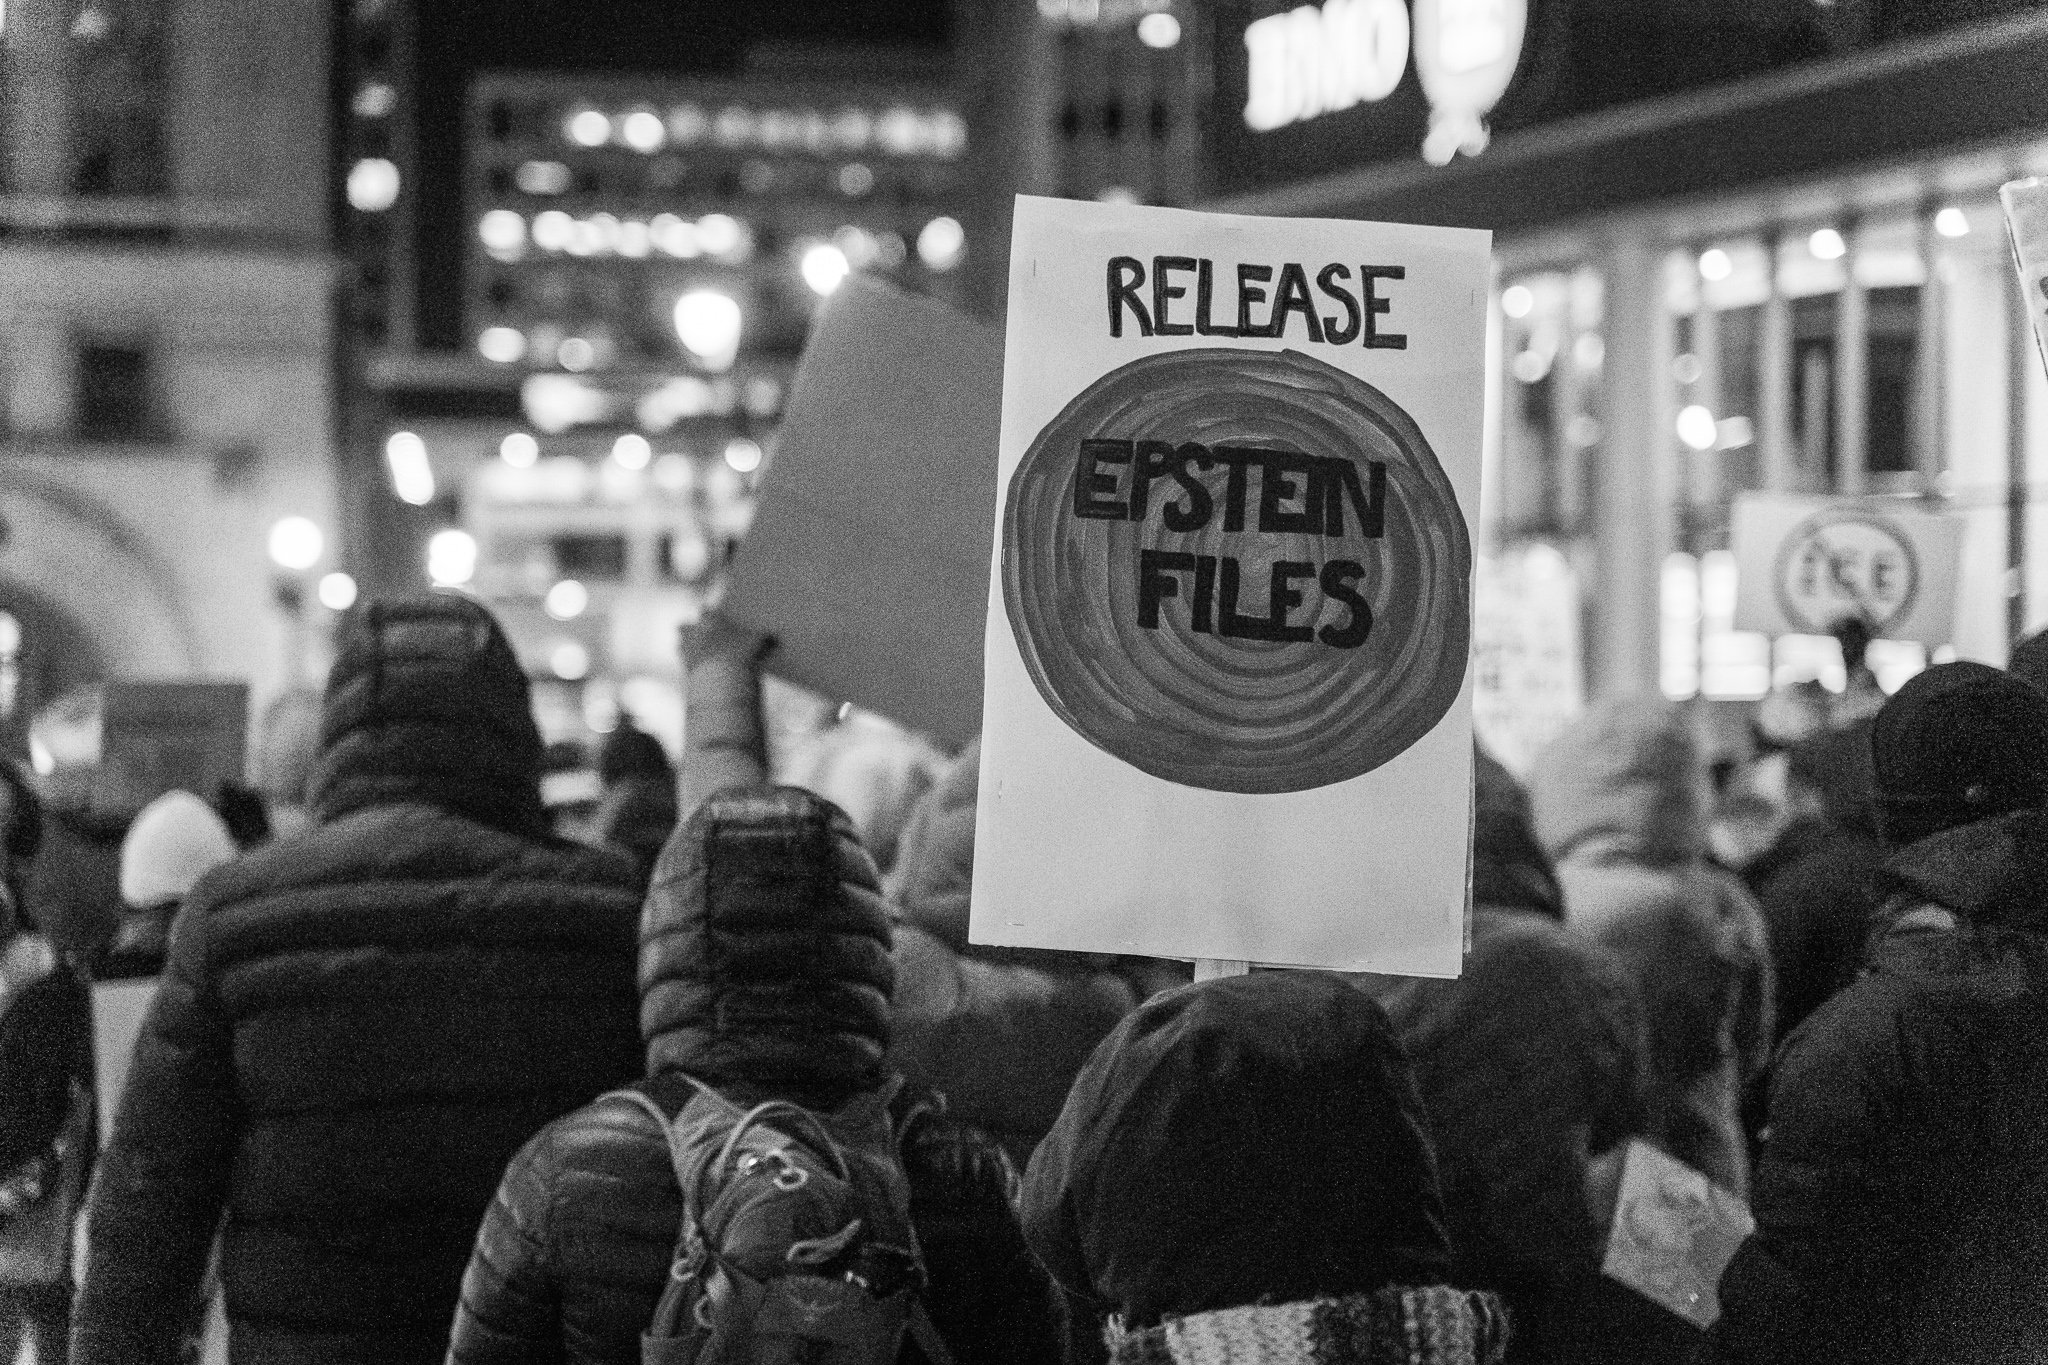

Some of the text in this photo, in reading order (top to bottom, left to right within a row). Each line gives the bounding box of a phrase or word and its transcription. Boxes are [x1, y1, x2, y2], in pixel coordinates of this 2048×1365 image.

[1107, 256, 1408, 349] RELEASE
[1074, 439, 1387, 538] EPSTEIN
[1137, 549, 1373, 649] FILES
